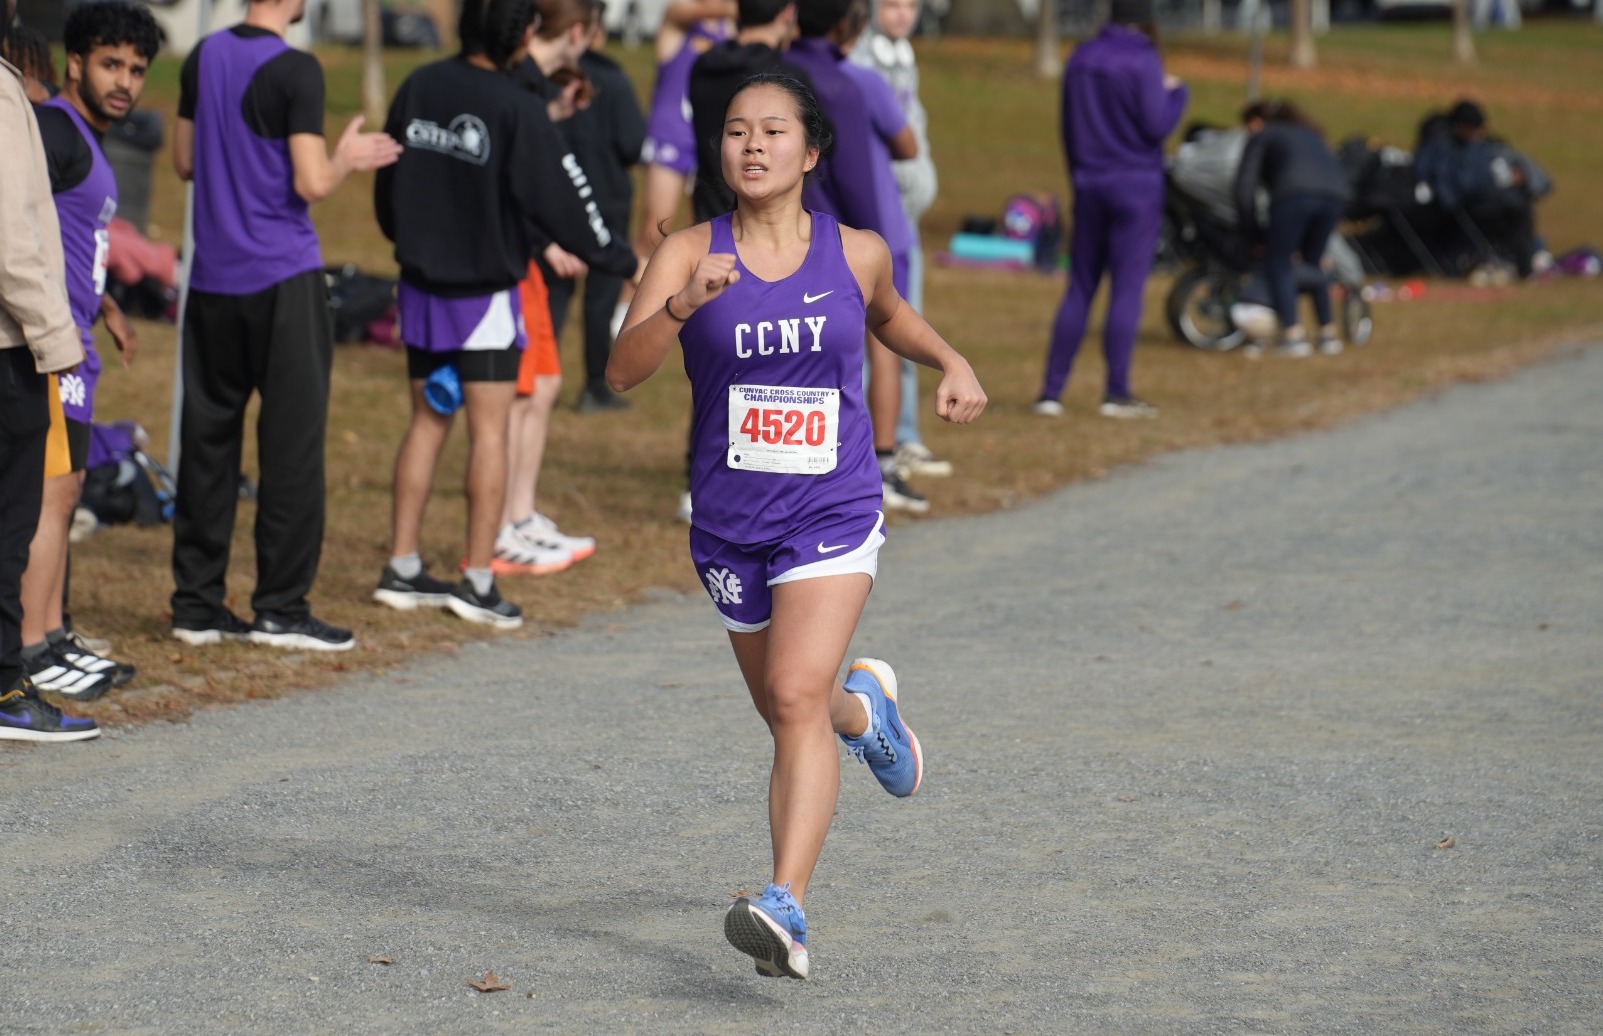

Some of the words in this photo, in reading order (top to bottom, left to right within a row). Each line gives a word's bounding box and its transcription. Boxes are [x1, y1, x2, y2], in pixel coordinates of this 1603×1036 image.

[734, 315, 827, 359] CCNY
[739, 387, 769, 395] CUNYAC
[770, 388, 795, 396] CROSS
[744, 394, 825, 405] CHAMPIONSHIPS
[740, 407, 826, 447] 4520
